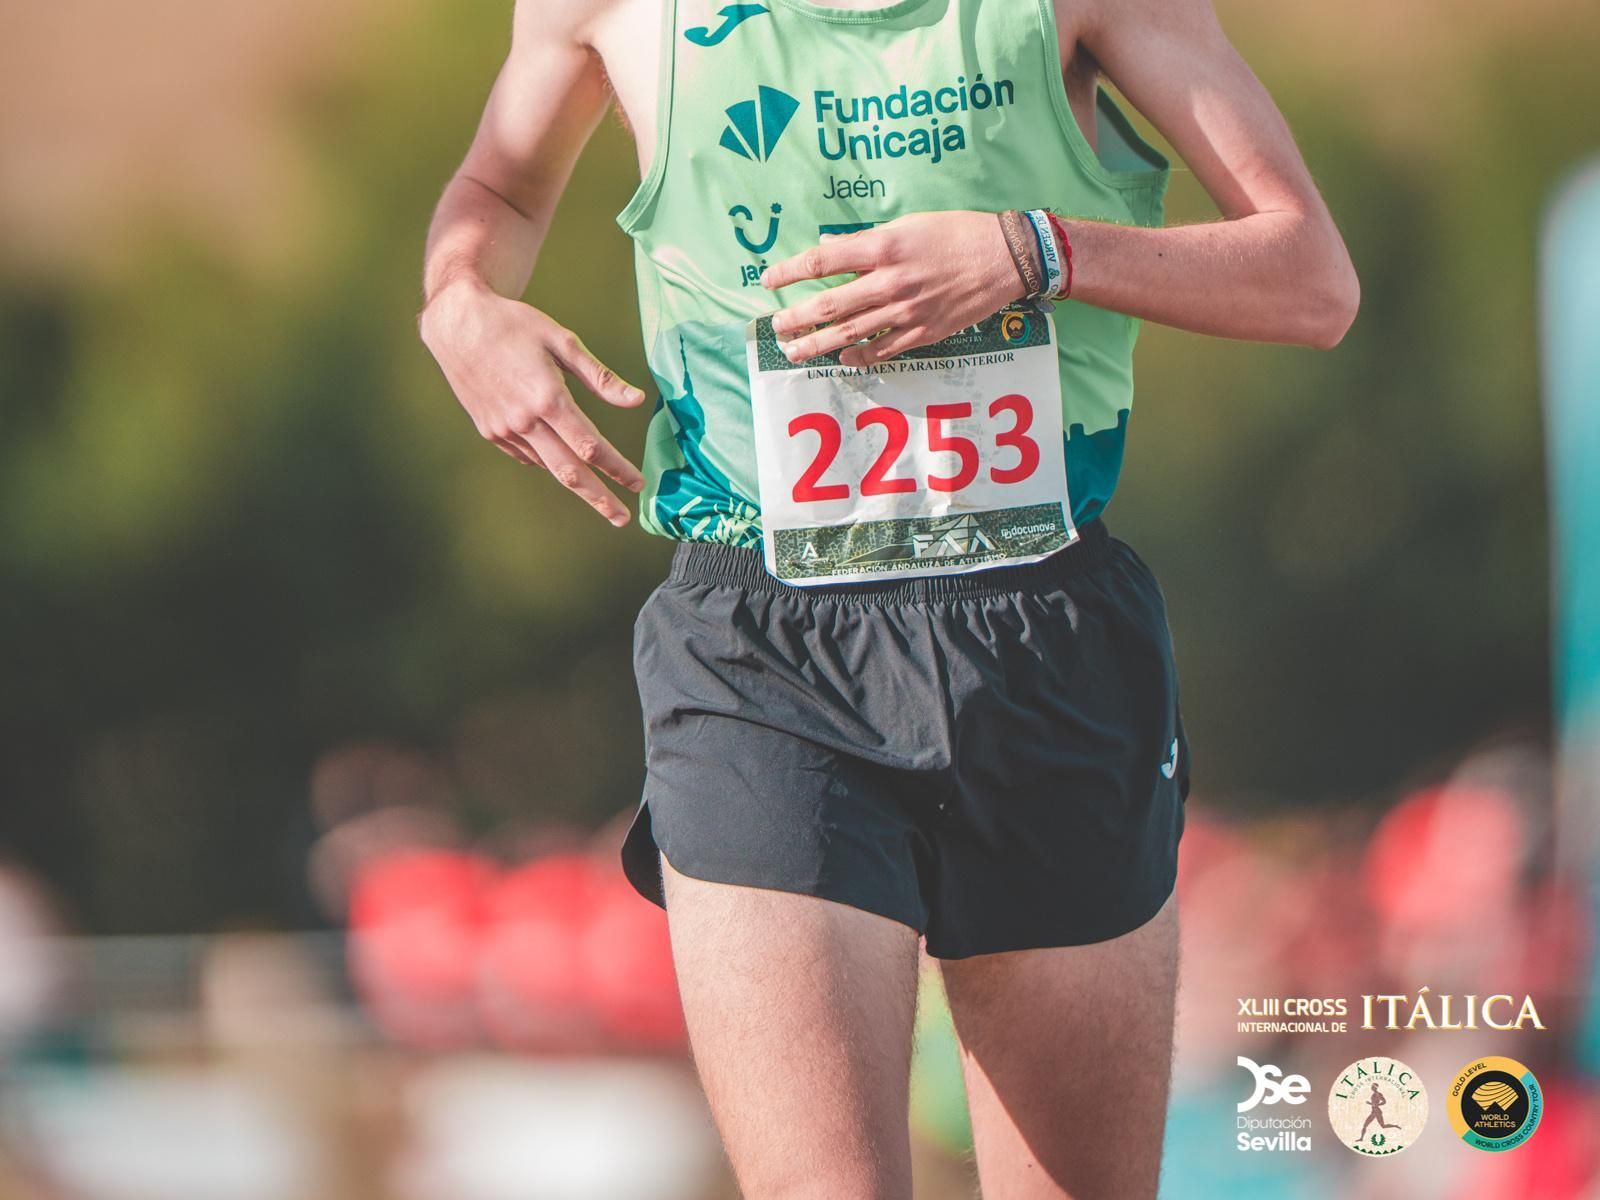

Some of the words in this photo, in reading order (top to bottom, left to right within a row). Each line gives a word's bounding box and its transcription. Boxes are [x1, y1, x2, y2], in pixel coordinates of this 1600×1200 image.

[814, 73, 1014, 123] Fundación
[817, 118, 966, 164] Unicaja
[823, 174, 886, 199] Jaén
[944, 335, 982, 345] COUNTRY
[807, 367, 861, 379] UNICAJA
[865, 363, 896, 375] JAEN
[900, 359, 955, 372] PARAISO
[958, 352, 1015, 368] INTERIOR
[787, 394, 1040, 503] 2253
[1011, 522, 1056, 536] docunova
[832, 563, 888, 576] FEDERACIÓN
[889, 558, 941, 570] ANDALUZA
[944, 558, 955, 567] DE
[959, 553, 1007, 566] ATLETISMO
